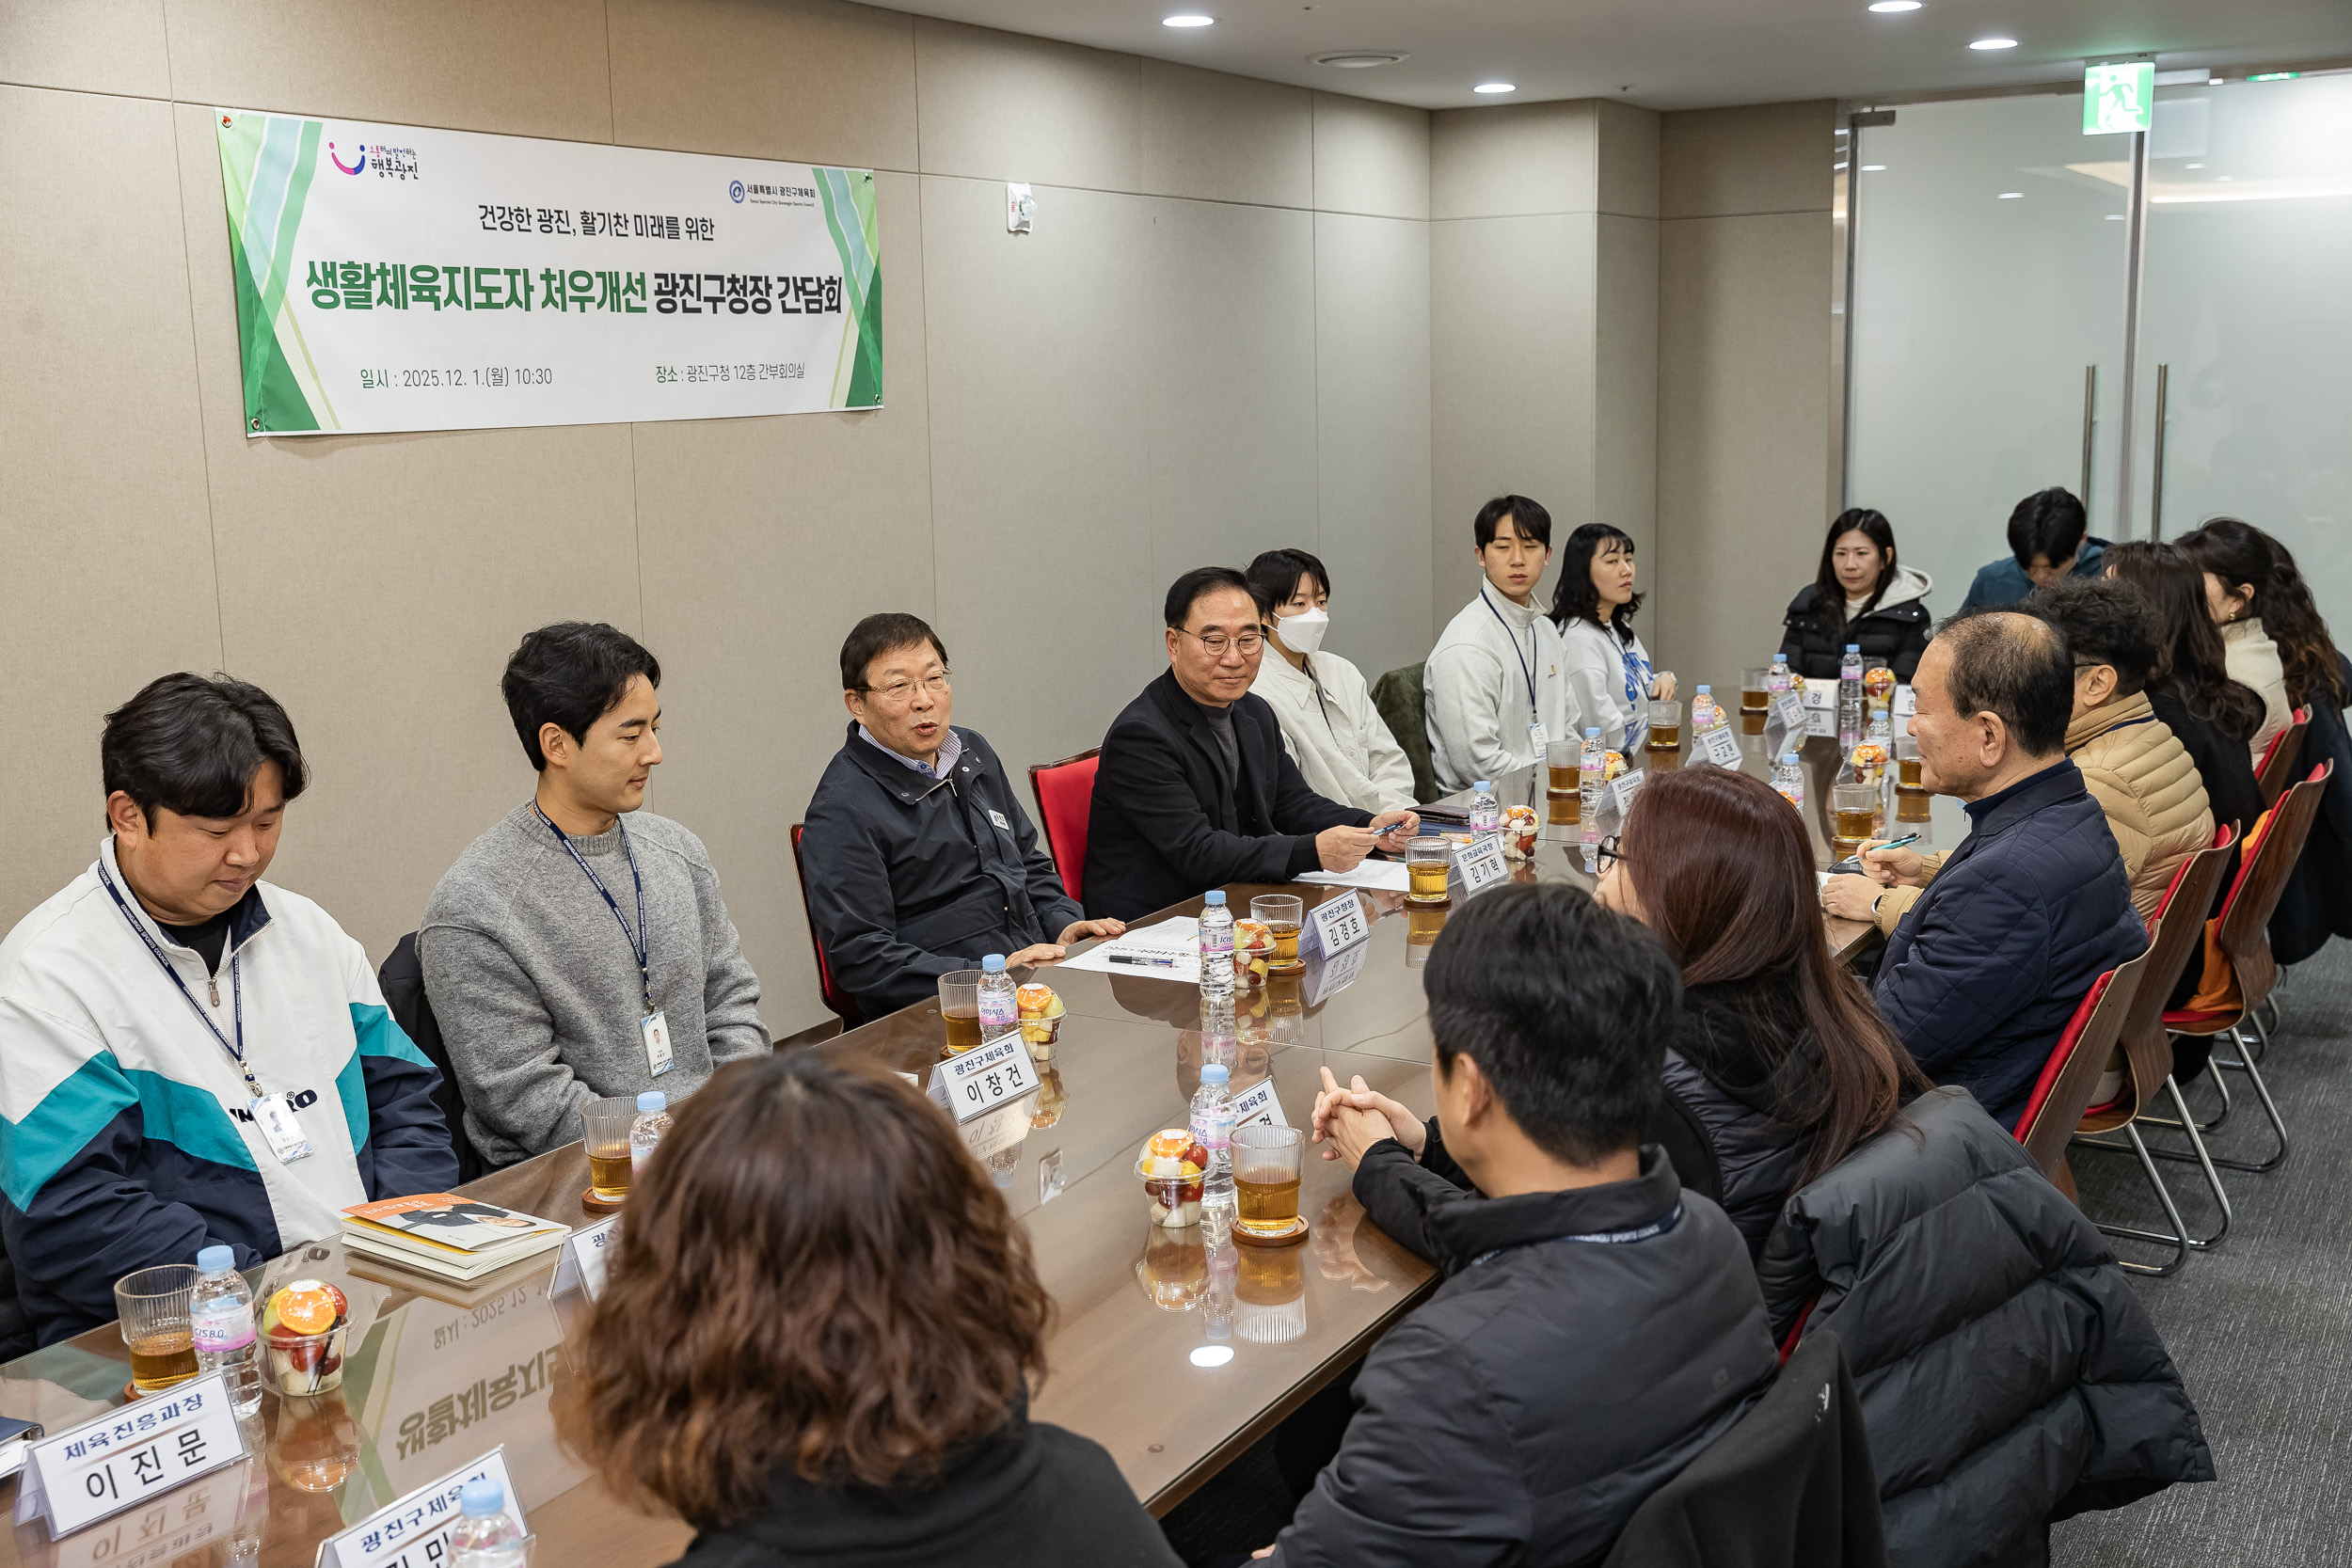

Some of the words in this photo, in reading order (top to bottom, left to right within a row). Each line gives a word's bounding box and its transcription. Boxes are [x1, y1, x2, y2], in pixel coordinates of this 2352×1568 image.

[371, 157, 419, 181] 행복광진
[746, 183, 778, 196] 서울특별시
[779, 186, 816, 198] 광진구체육회
[478, 204, 532, 232] 건강한
[536, 208, 577, 236] 광진,
[580, 211, 629, 237] 활기찬
[633, 214, 681, 241] 미래를
[685, 217, 715, 242] 위한
[306, 261, 534, 312] 생활체육지도자
[540, 267, 647, 313] 처우개선
[654, 272, 772, 315] 광진구청장
[776, 275, 843, 314] 간담회
[360, 368, 389, 388] 일시
[403, 369, 467, 388] 2025.12.
[472, 366, 509, 388] 1.(월)
[515, 367, 552, 385] 10:30
[656, 365, 678, 384] 장소
[687, 364, 730, 383] 광진구청
[733, 364, 756, 381] 12층
[758, 362, 805, 380] 간부회의실
[564, 839, 582, 863] GWANGJINGU
[580, 861, 594, 877] SPORTS
[591, 875, 604, 892] COUNCIL
[1461, 842, 1494, 862] 문화교육국장
[1470, 858, 1501, 883] 김기혁
[613, 907, 630, 932] GWANGJINGU
[1320, 898, 1355, 922] 광진구청장
[120, 904, 143, 932] GWANGJINGU
[141, 931, 156, 949] SPORTS
[153, 947, 168, 967] COUNCIL
[1328, 916, 1360, 947] 김경호
[954, 1042, 1014, 1075] 광진구체육회
[966, 1063, 1024, 1103] 이창건
[1236, 1090, 1267, 1114] 체육회
[63, 1393, 204, 1461] 체육진흥과장
[86, 1429, 207, 1499] 이진문
